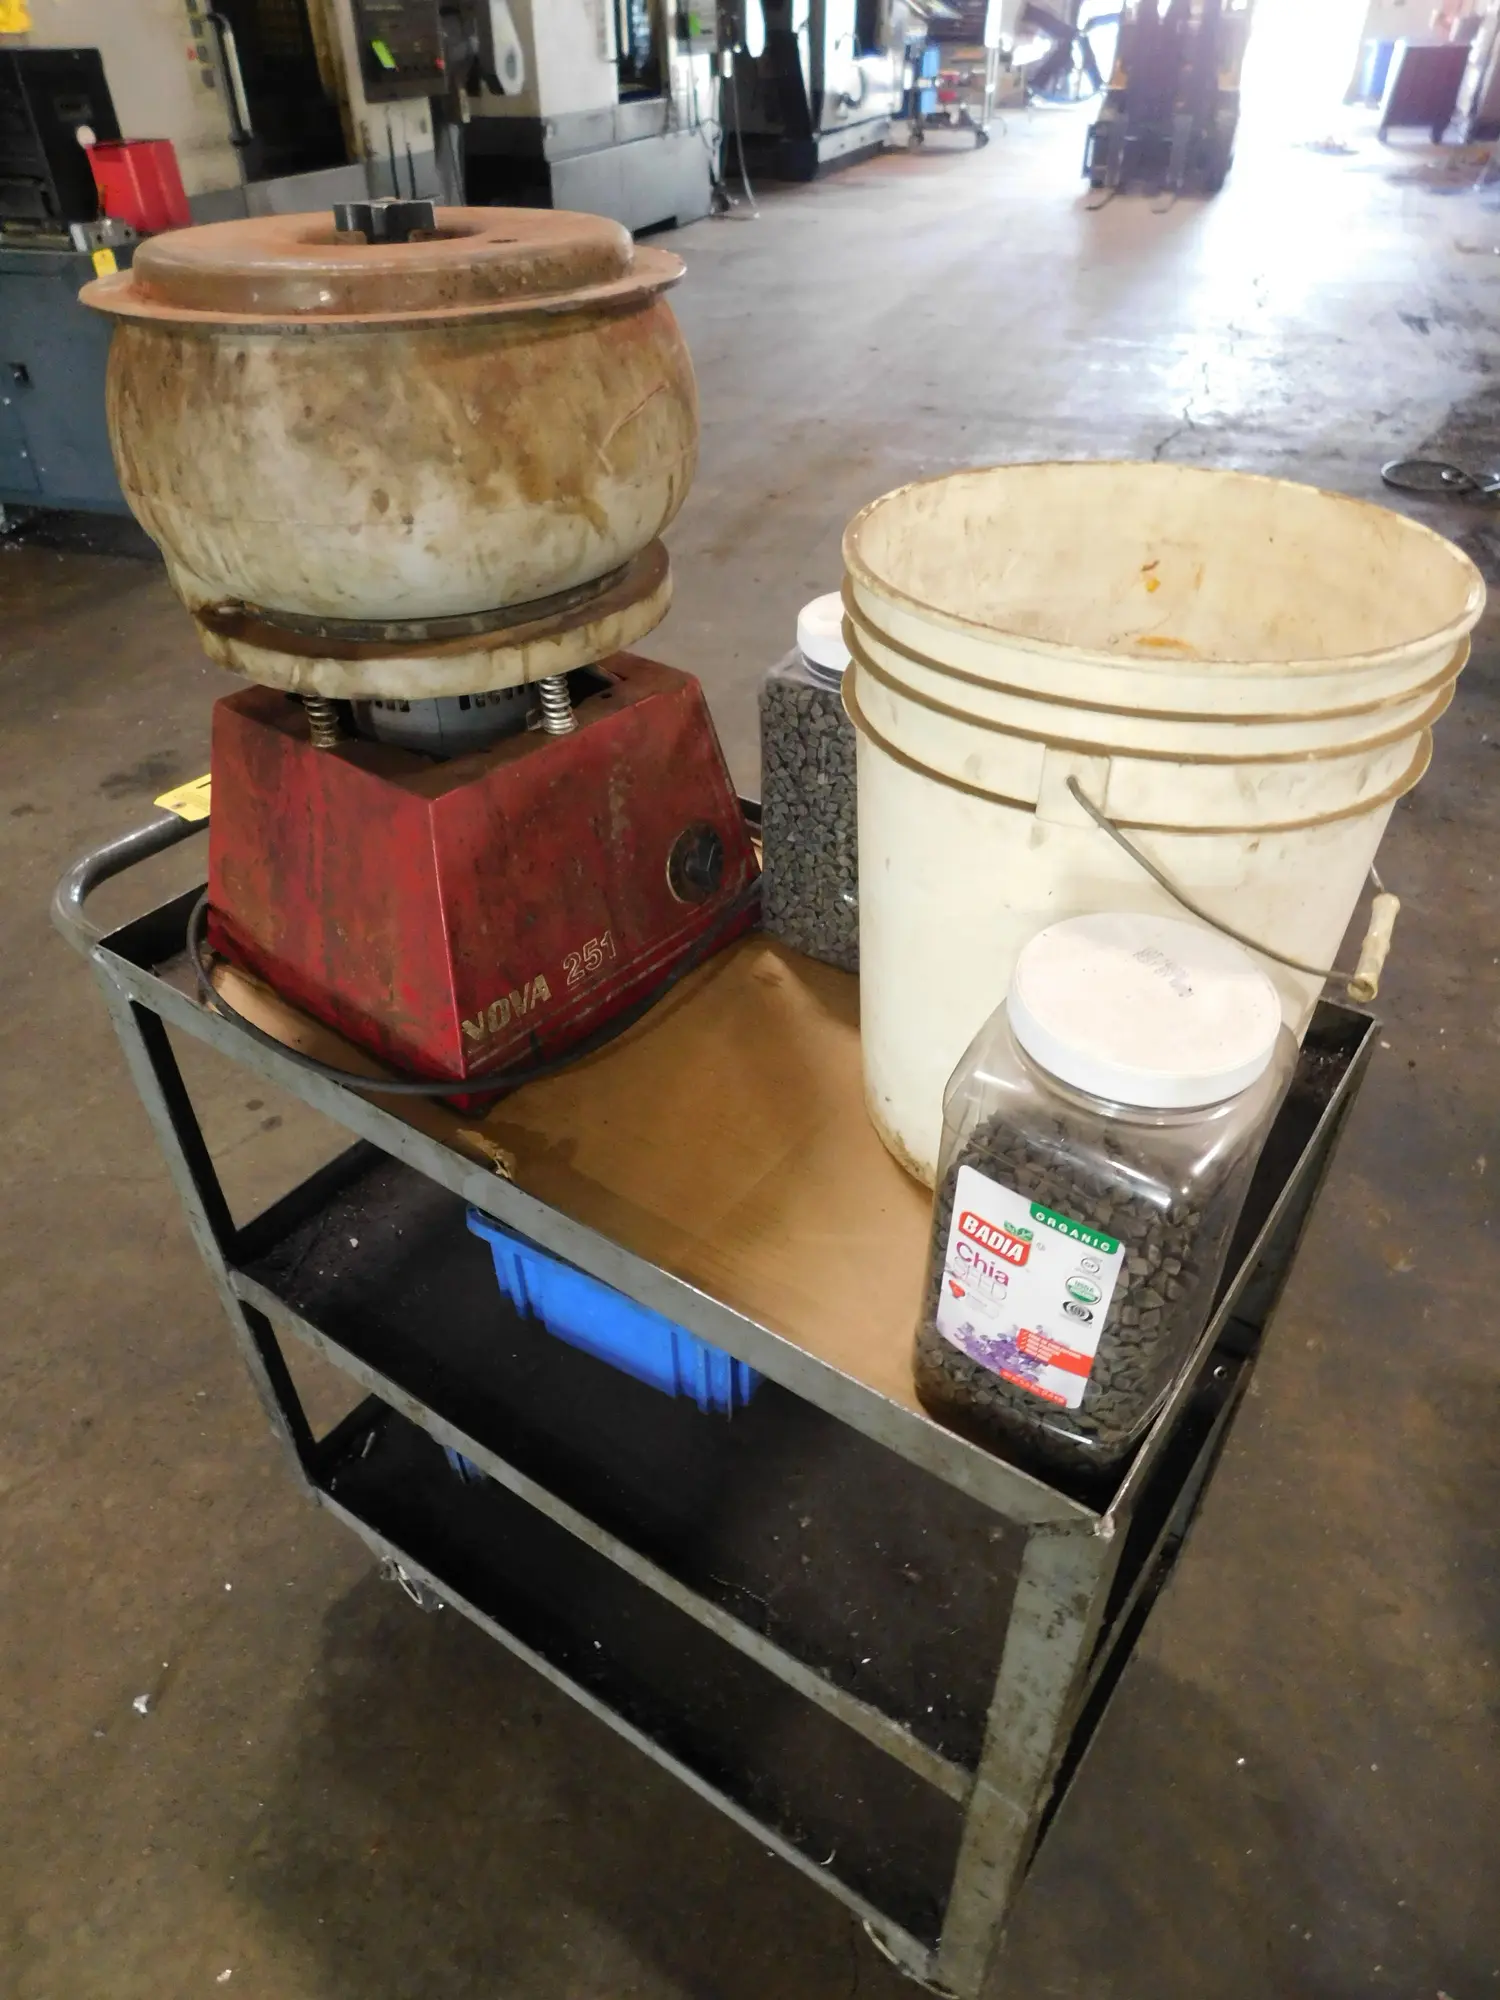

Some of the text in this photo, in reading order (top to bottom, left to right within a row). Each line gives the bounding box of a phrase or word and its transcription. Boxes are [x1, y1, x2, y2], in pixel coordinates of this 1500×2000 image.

[562, 929, 617, 986] 251
[962, 1214, 1025, 1263] BADIA
[1035, 1211, 1111, 1252] ORGANIC
[956, 1241, 1009, 1287] Chia
